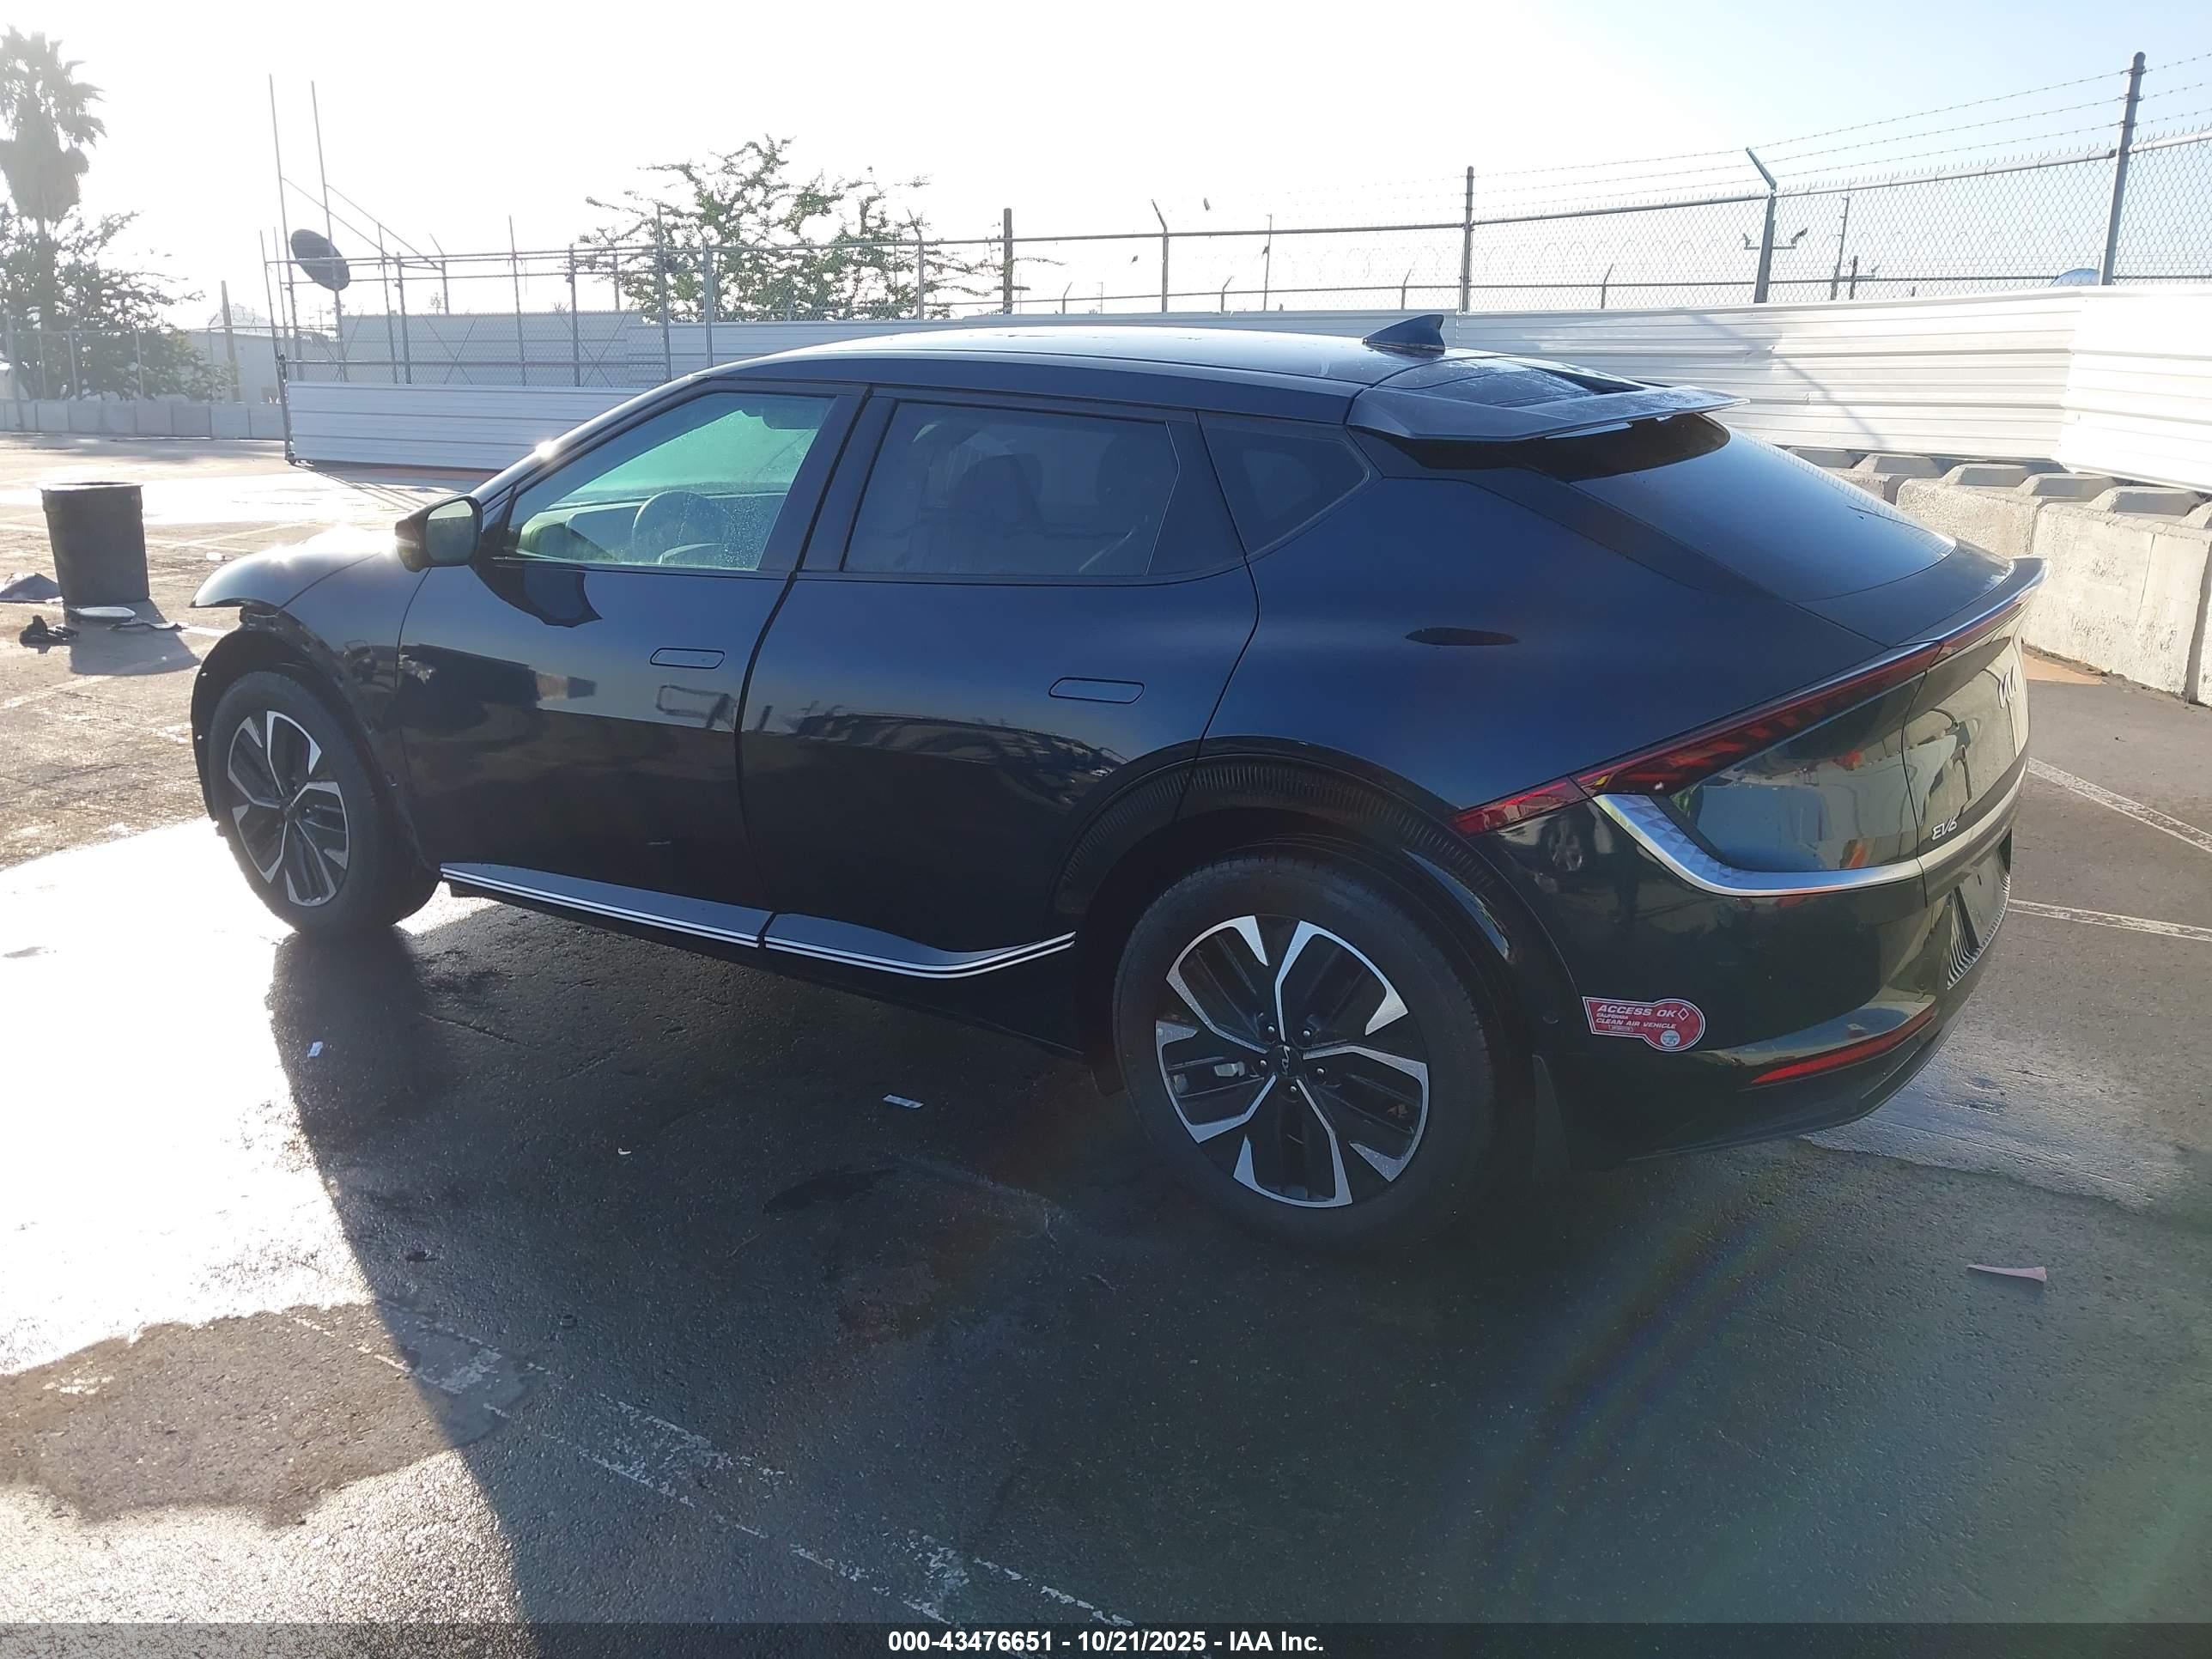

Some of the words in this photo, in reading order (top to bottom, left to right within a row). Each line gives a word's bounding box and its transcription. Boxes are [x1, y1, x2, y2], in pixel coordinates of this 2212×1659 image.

[1931, 816, 1958, 841] EV6
[1597, 1005, 1652, 1016] ACCESS
[1657, 1009, 1678, 1018] OK
